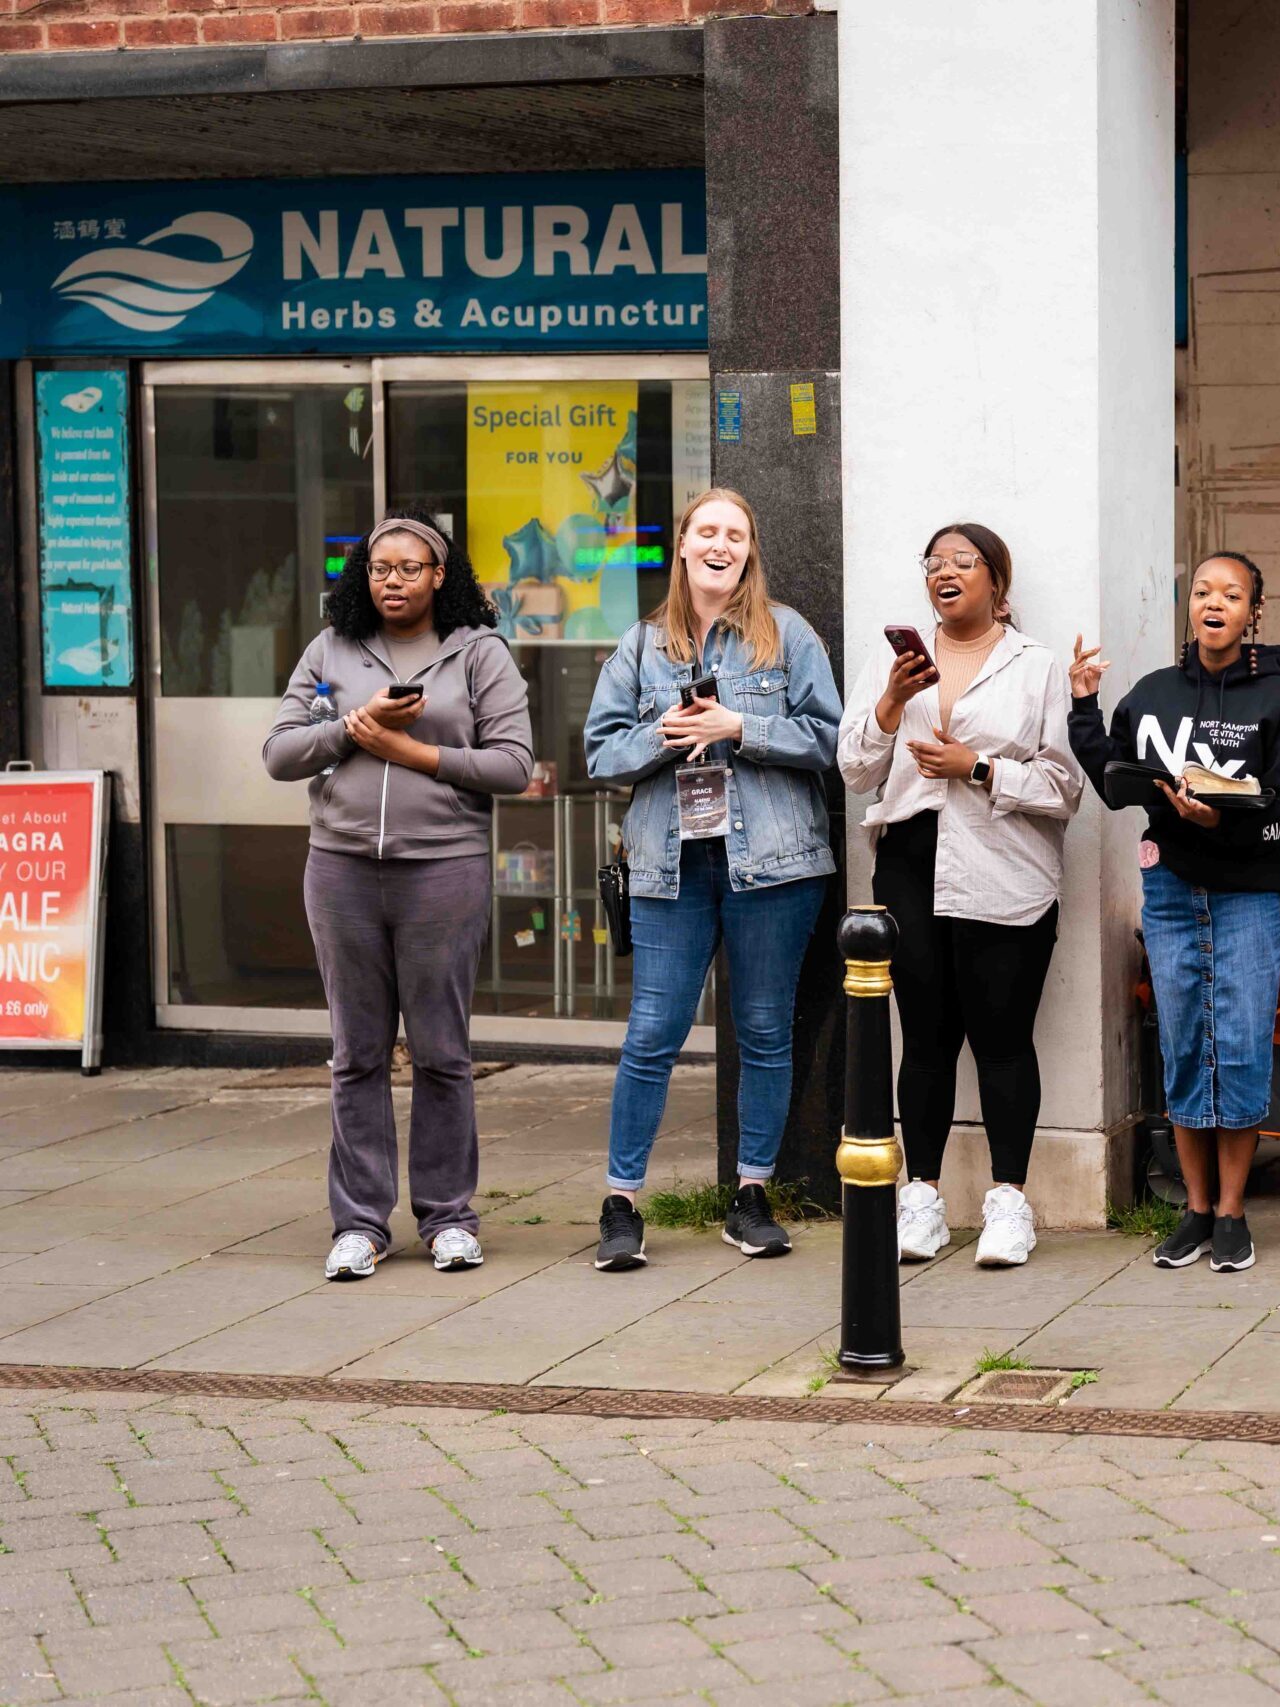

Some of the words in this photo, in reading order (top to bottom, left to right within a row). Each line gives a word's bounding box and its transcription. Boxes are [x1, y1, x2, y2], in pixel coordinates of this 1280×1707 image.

[282, 203, 708, 281] NATURAL
[282, 300, 397, 330] Herbs
[414, 298, 443, 328] &
[460, 298, 703, 333] Acupunctur
[473, 404, 561, 433] Special
[569, 403, 617, 427] Gift
[506, 452, 538, 464] FOR
[546, 452, 583, 464] YOU
[1209, 729, 1246, 740] CENTRAL
[1211, 737, 1240, 748] YOUTH
[691, 787, 713, 796] GRACE
[23, 811, 68, 825] About
[16, 860, 66, 882] OUR
[0, 891, 61, 932] ALE
[6, 1002, 21, 1016] £6
[24, 1001, 49, 1018] only
